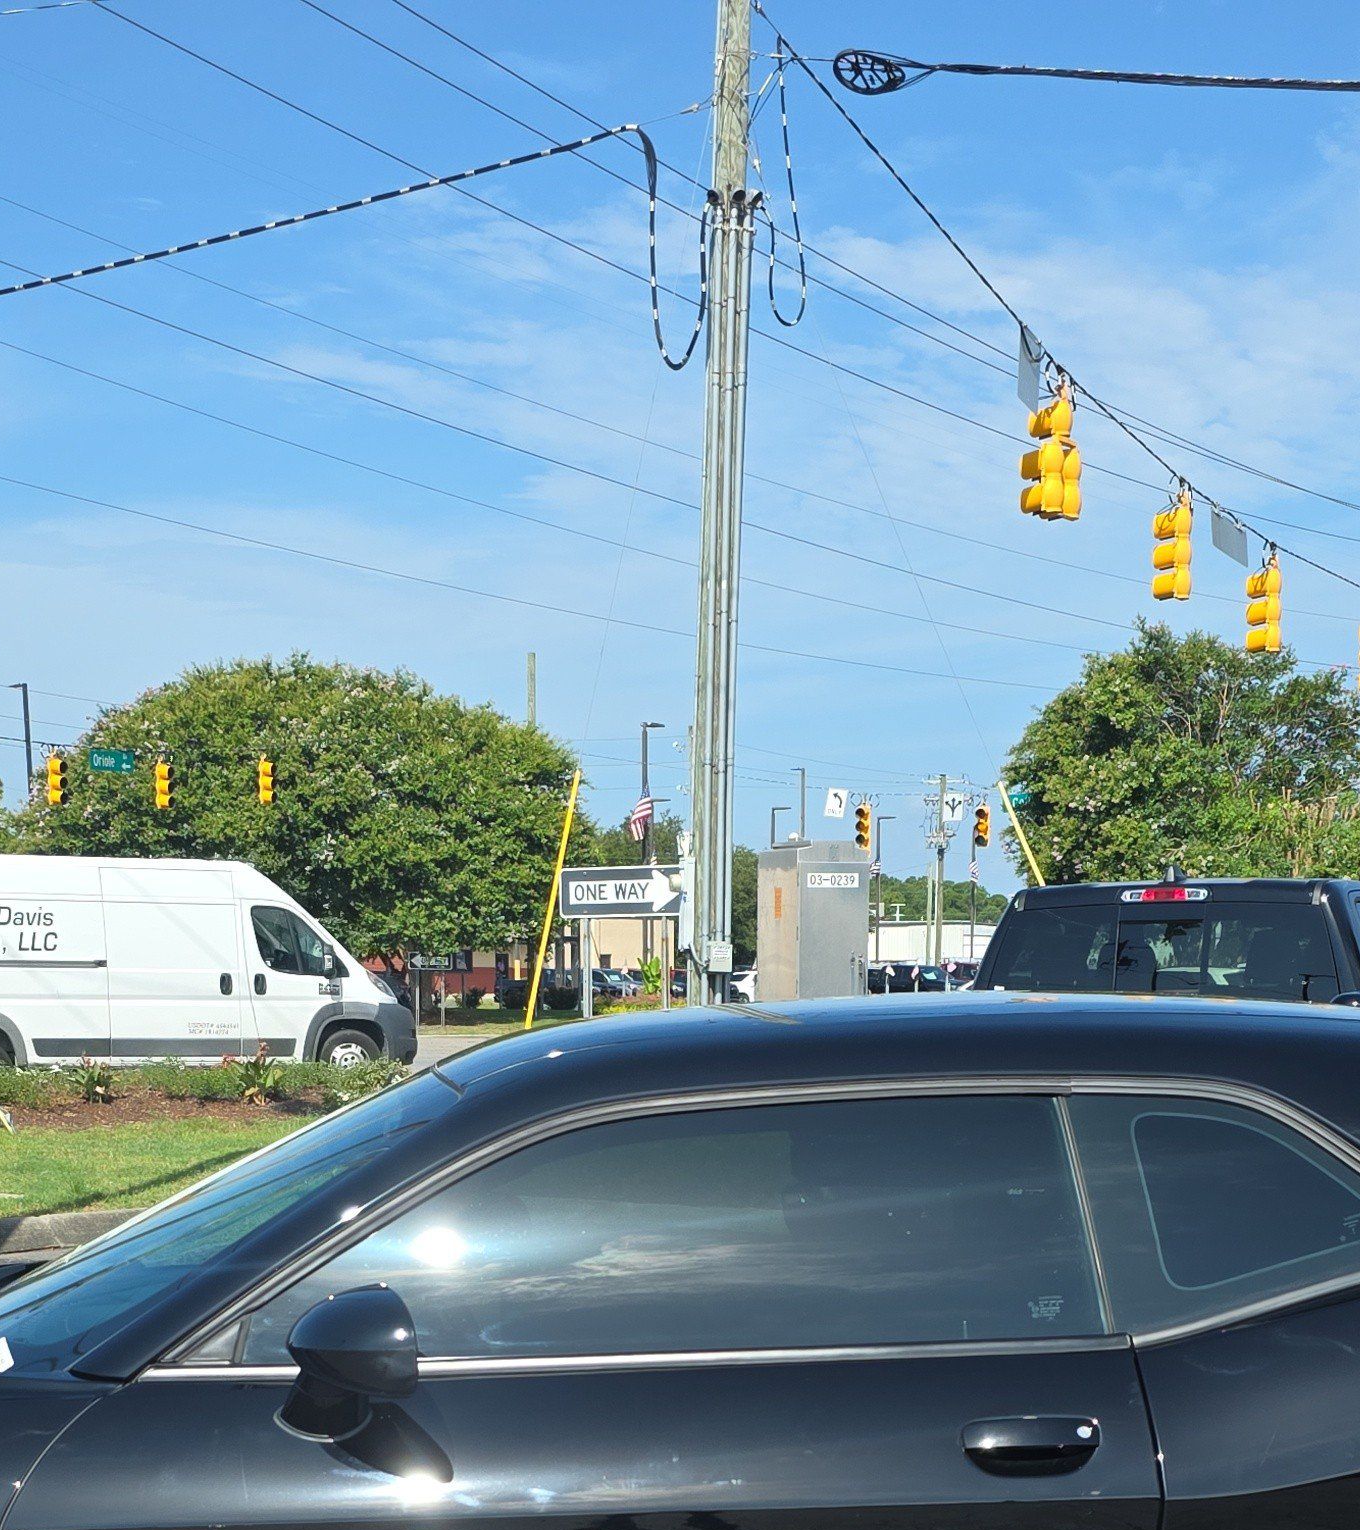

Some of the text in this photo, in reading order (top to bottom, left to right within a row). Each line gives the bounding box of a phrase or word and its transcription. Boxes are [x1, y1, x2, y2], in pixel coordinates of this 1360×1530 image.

[93, 753, 115, 767] Oriole
[810, 874, 856, 886] 03-0239
[574, 881, 650, 901] ONE WAY
[17, 931, 58, 952] LLC
